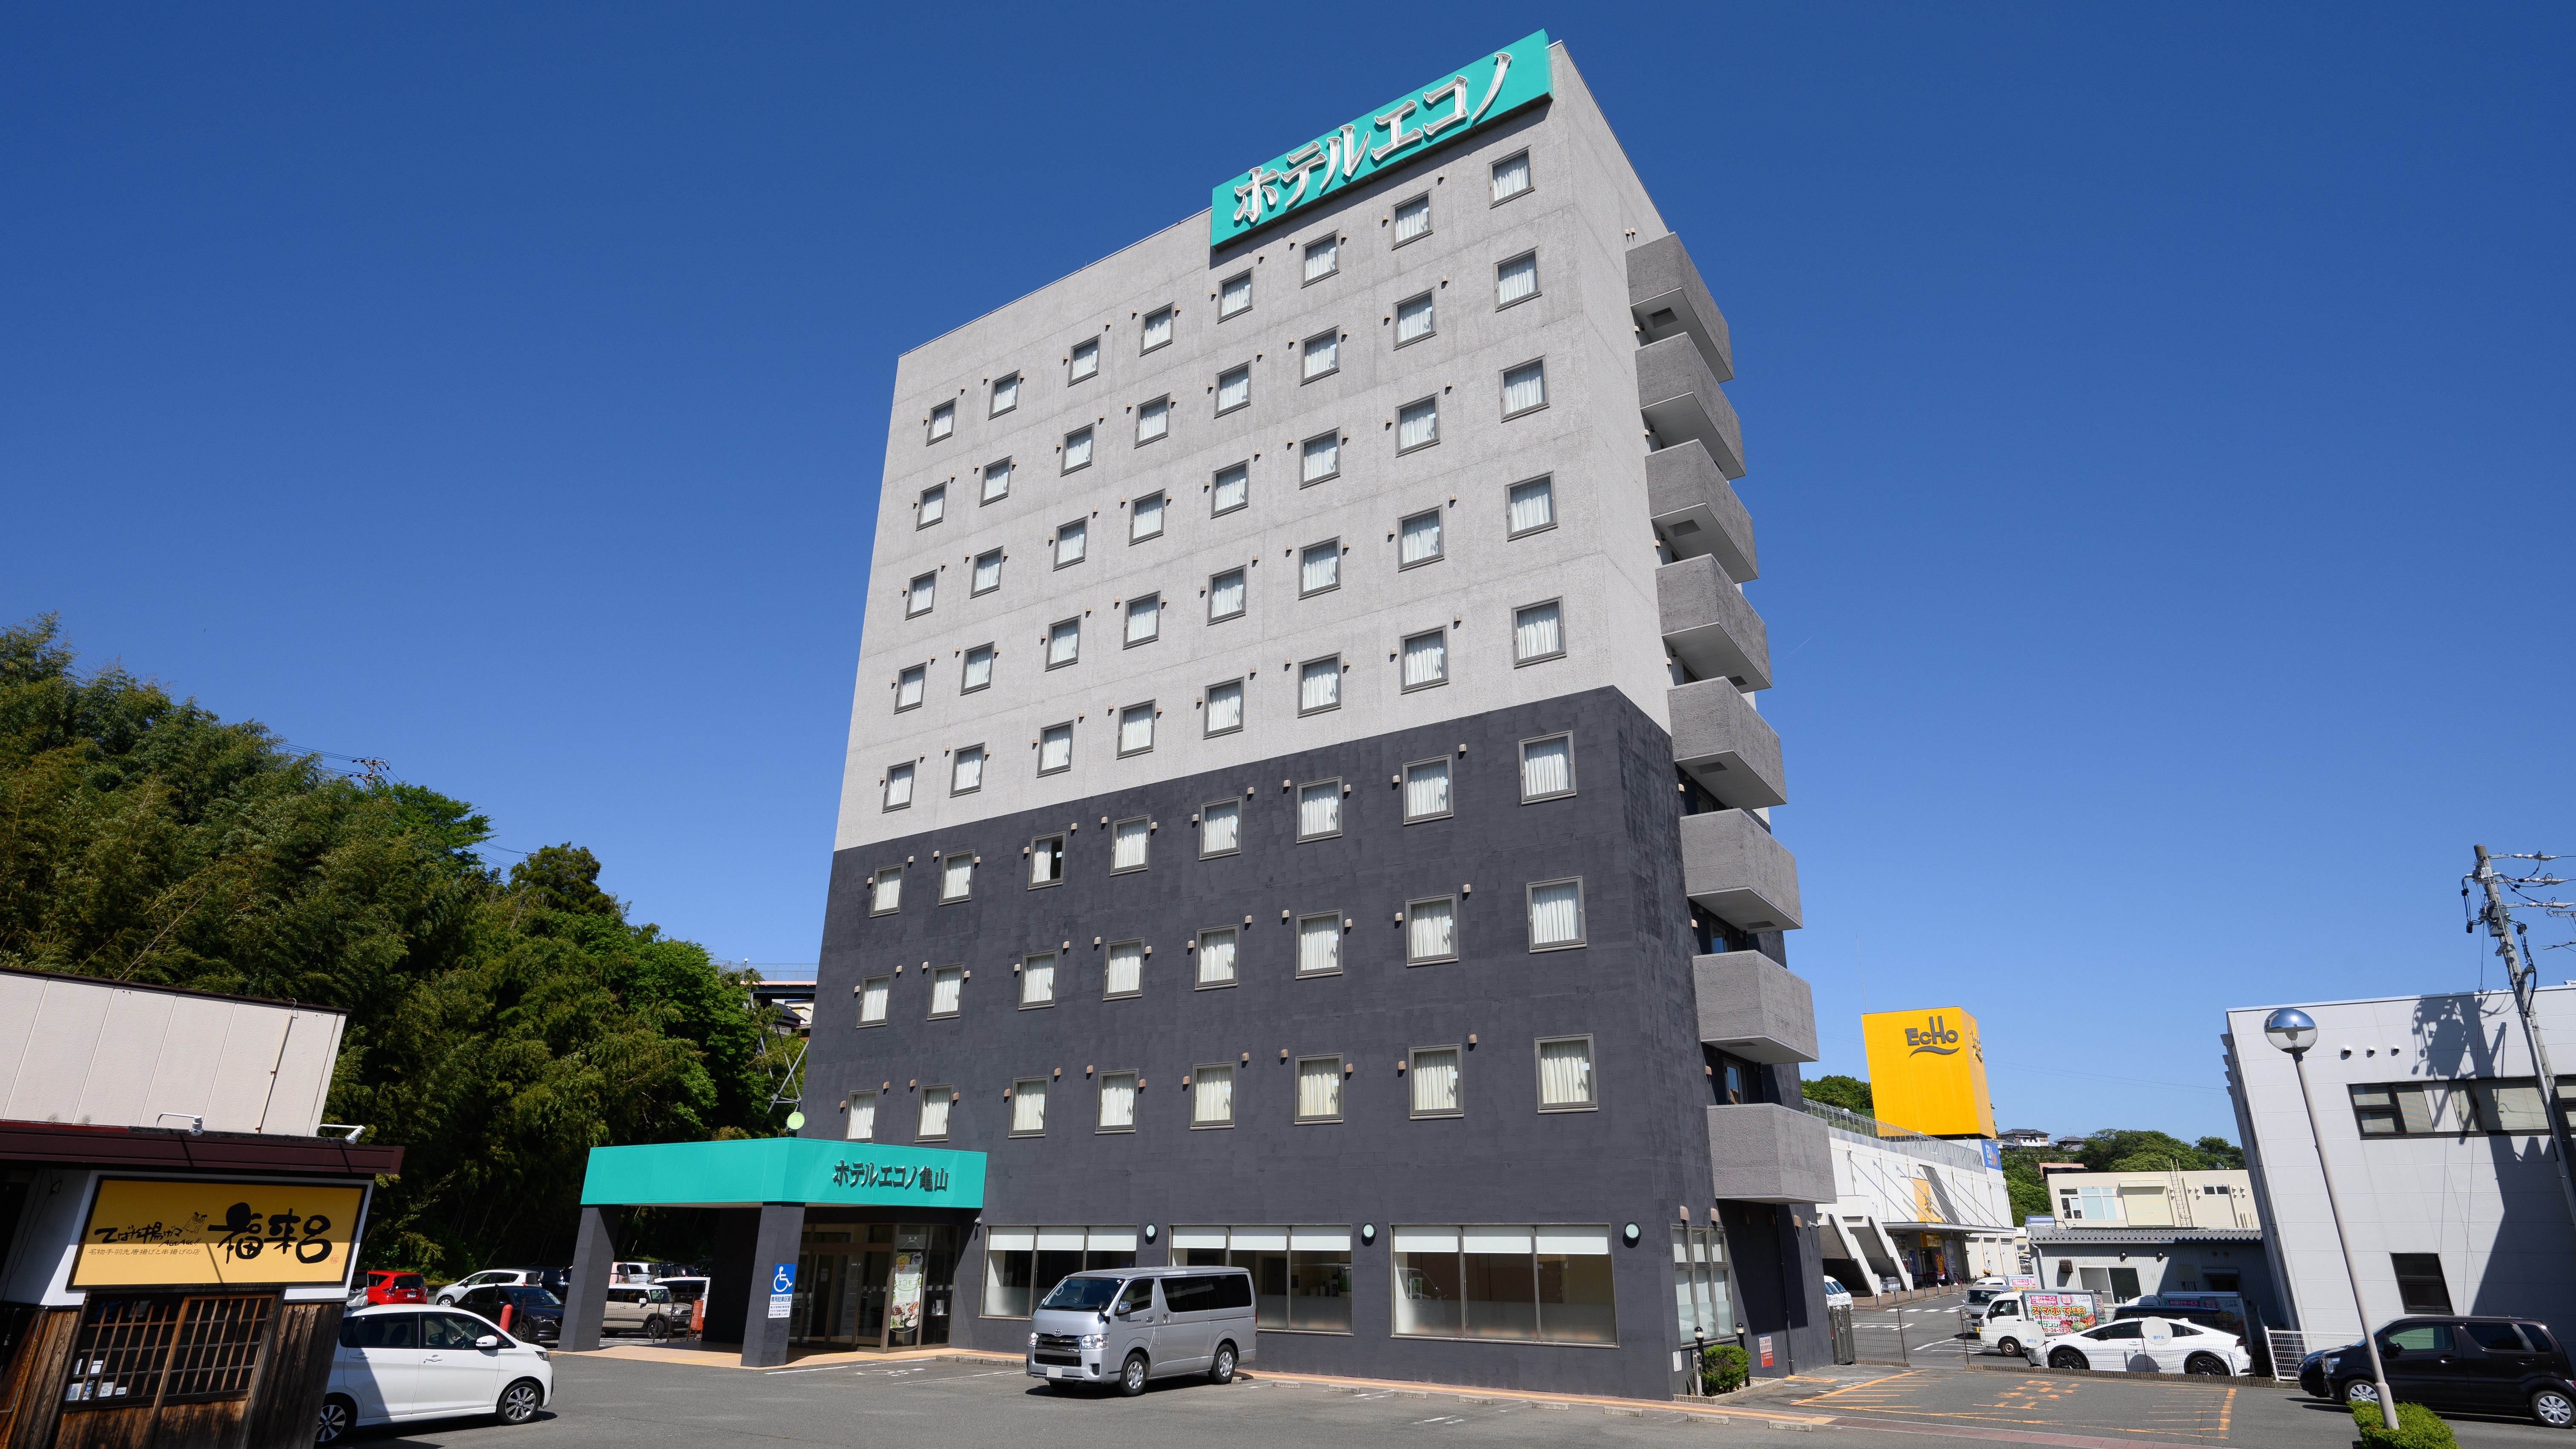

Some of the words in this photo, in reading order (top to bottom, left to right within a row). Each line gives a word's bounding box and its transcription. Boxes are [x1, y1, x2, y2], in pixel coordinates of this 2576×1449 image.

[1233, 52, 1512, 223] ホテルエコノ
[833, 1160, 949, 1191] ホテルエコノ亀山
